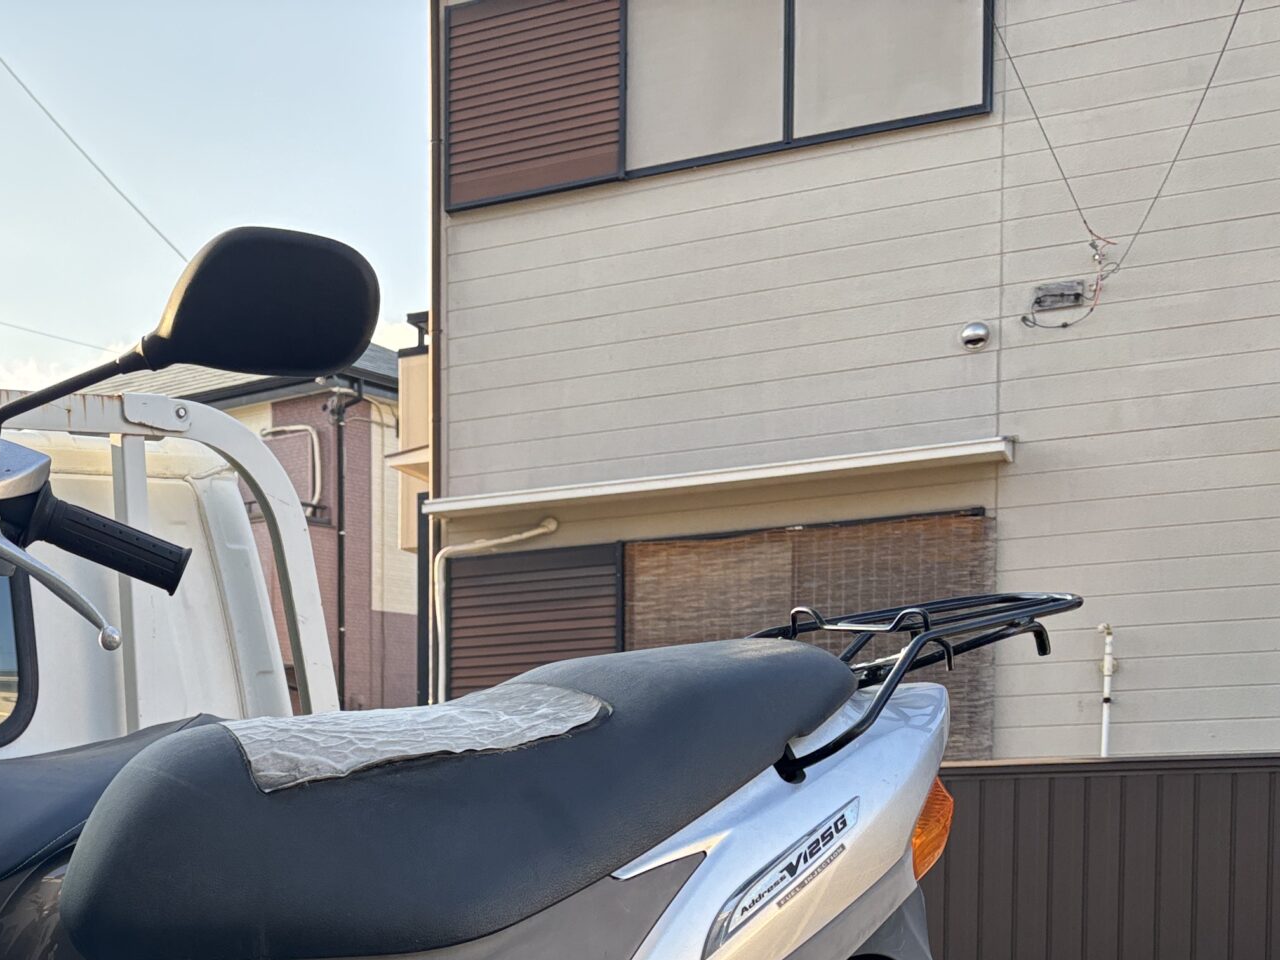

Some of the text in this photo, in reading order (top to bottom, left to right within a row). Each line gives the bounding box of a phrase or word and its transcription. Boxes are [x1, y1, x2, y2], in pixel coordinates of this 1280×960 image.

[740, 813, 847, 916] Address V125G
[780, 846, 844, 906] FUEL INJECTION
